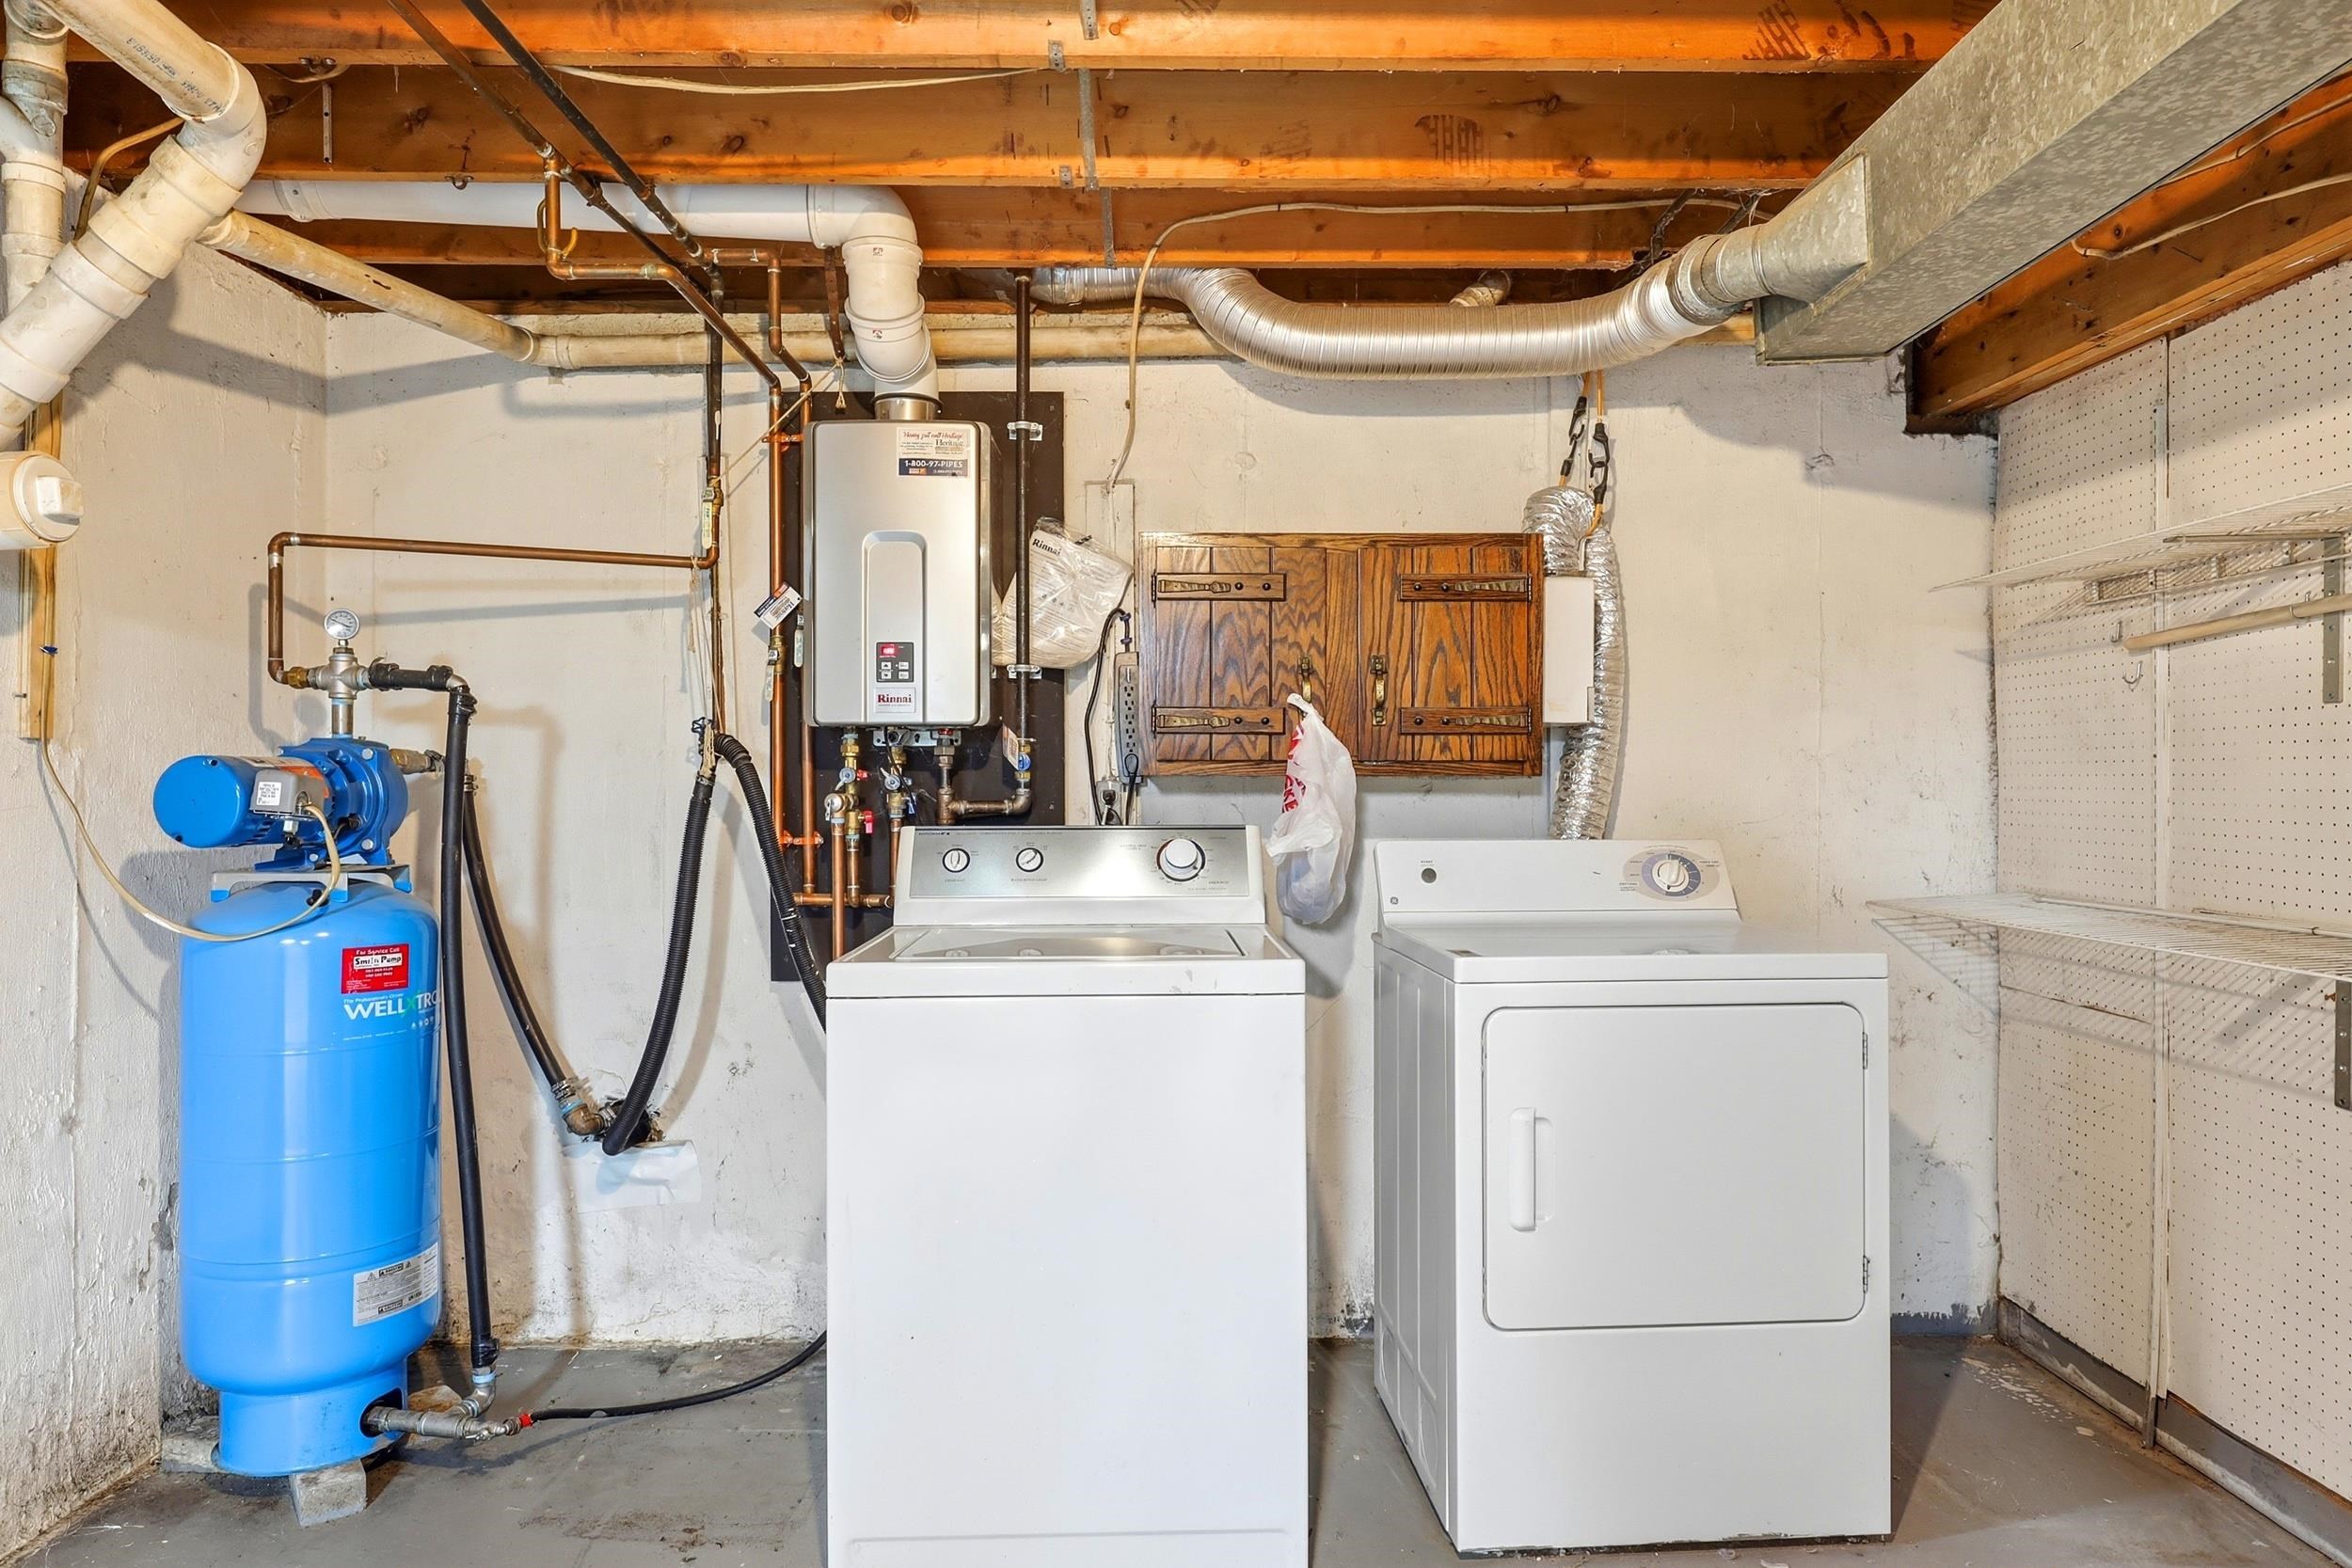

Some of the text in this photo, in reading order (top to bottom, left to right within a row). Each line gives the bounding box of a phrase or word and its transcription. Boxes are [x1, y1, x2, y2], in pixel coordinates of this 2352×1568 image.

[904, 459, 963, 467] 1-800-97-PIPES
[1032, 538, 1061, 556] Rinnai
[877, 694, 912, 703] Rinnai
[381, 956, 402, 964] Pump
